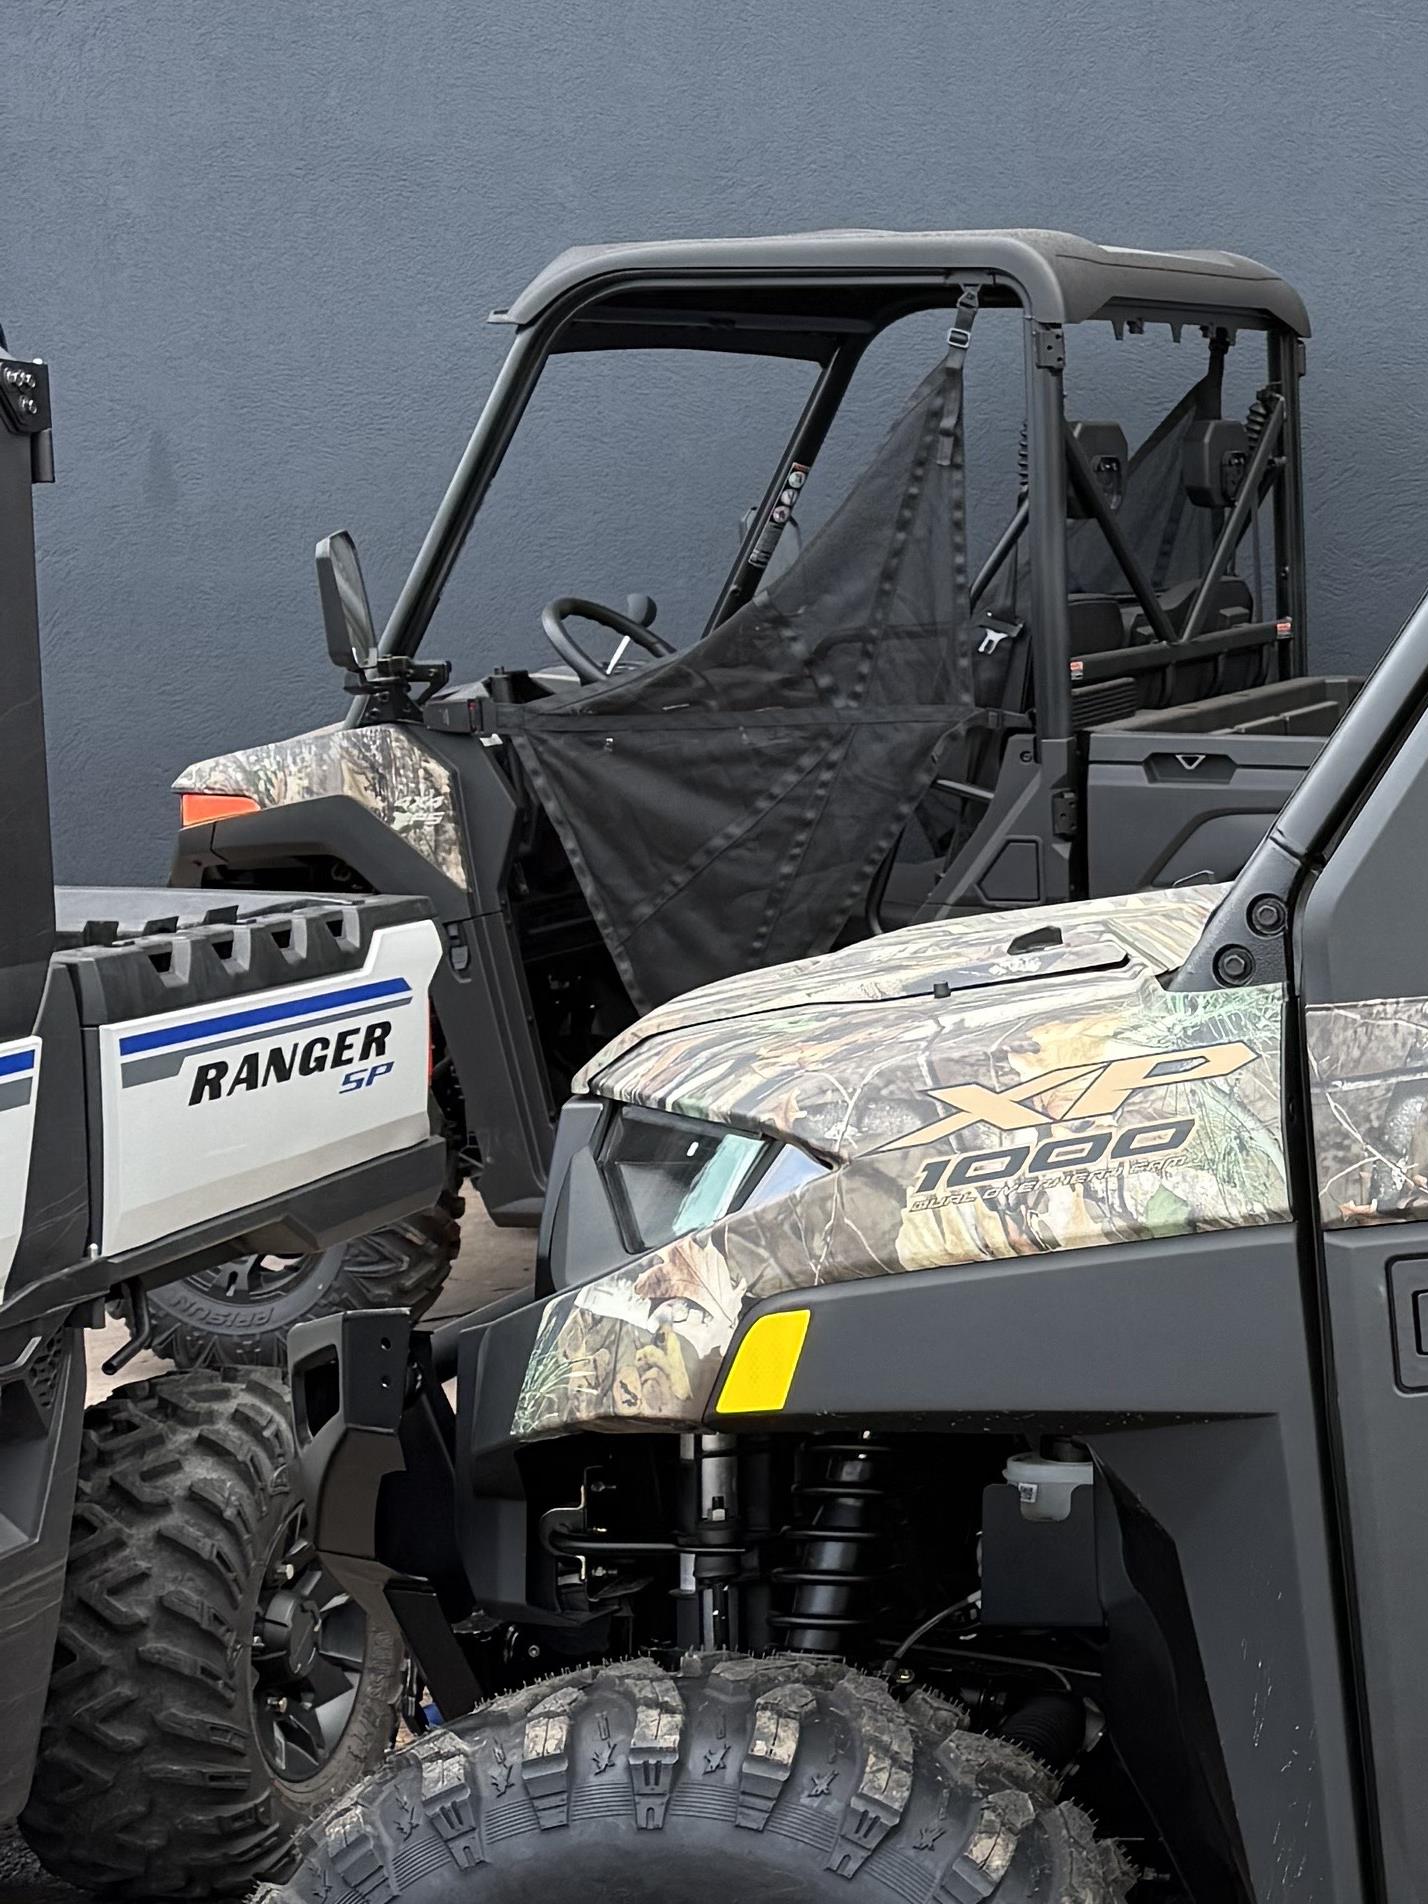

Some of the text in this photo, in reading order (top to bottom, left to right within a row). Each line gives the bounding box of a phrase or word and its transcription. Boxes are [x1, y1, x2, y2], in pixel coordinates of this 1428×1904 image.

[188, 1021, 392, 1106] RANGER
[338, 1061, 395, 1094] SP
[860, 1040, 1260, 1157] XP
[911, 1116, 1198, 1195] 1000
